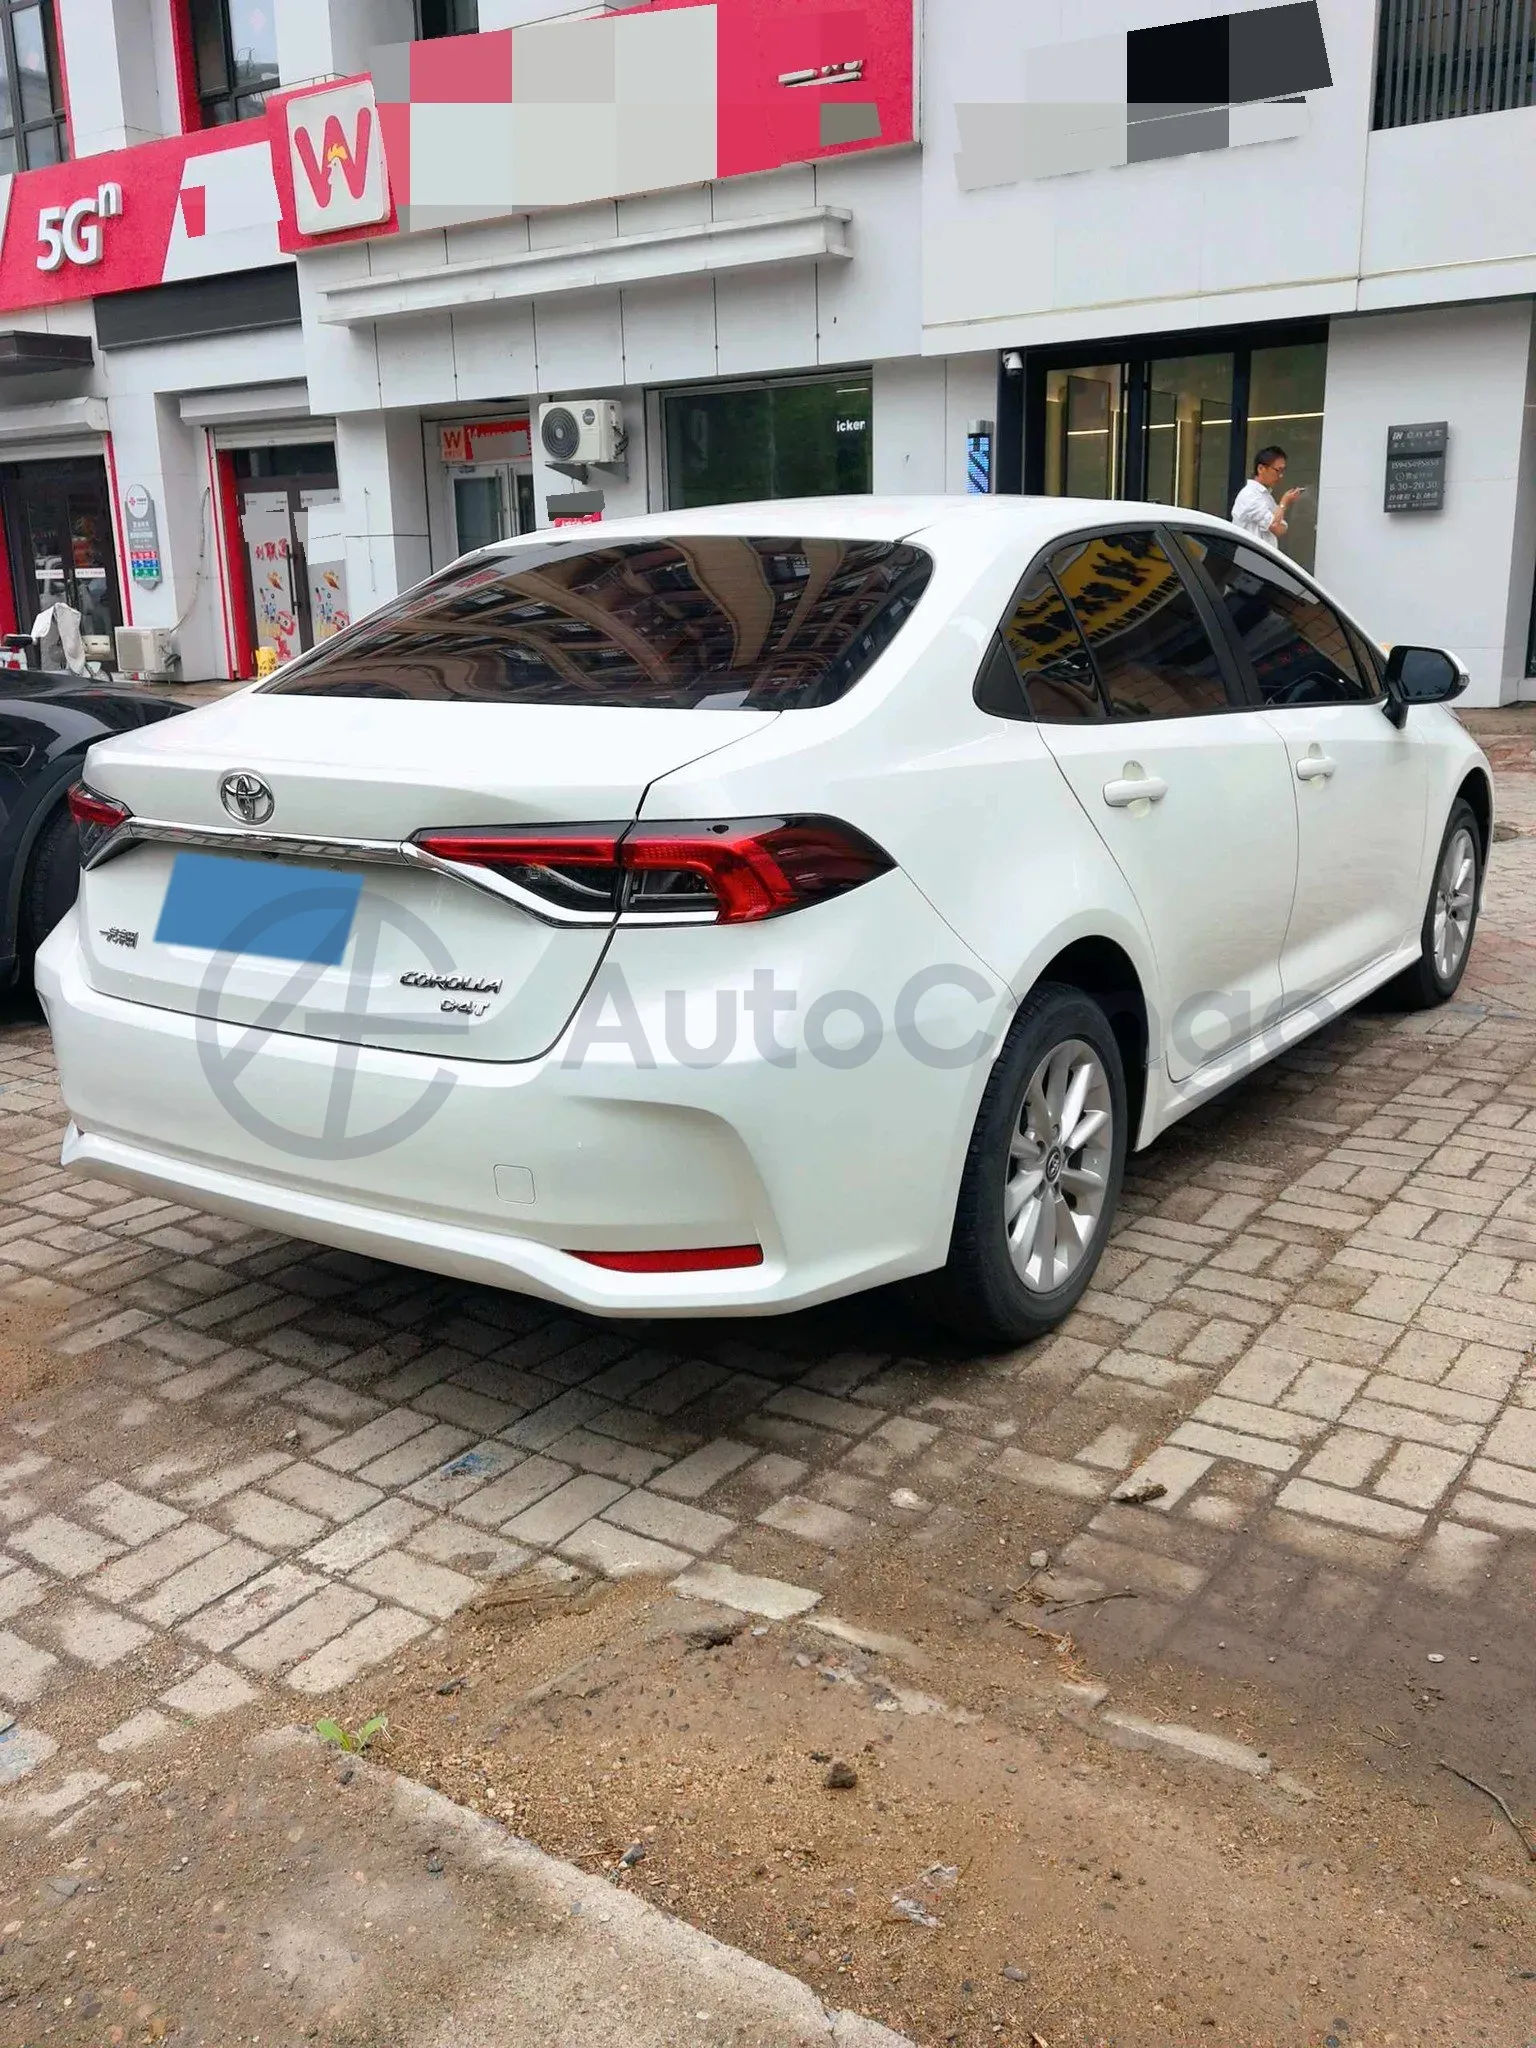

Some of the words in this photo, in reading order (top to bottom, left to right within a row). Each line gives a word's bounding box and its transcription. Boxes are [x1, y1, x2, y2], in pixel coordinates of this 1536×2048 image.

[293, 107, 371, 208] W
[836, 420, 866, 432] icker
[399, 971, 504, 995] COROLLA
